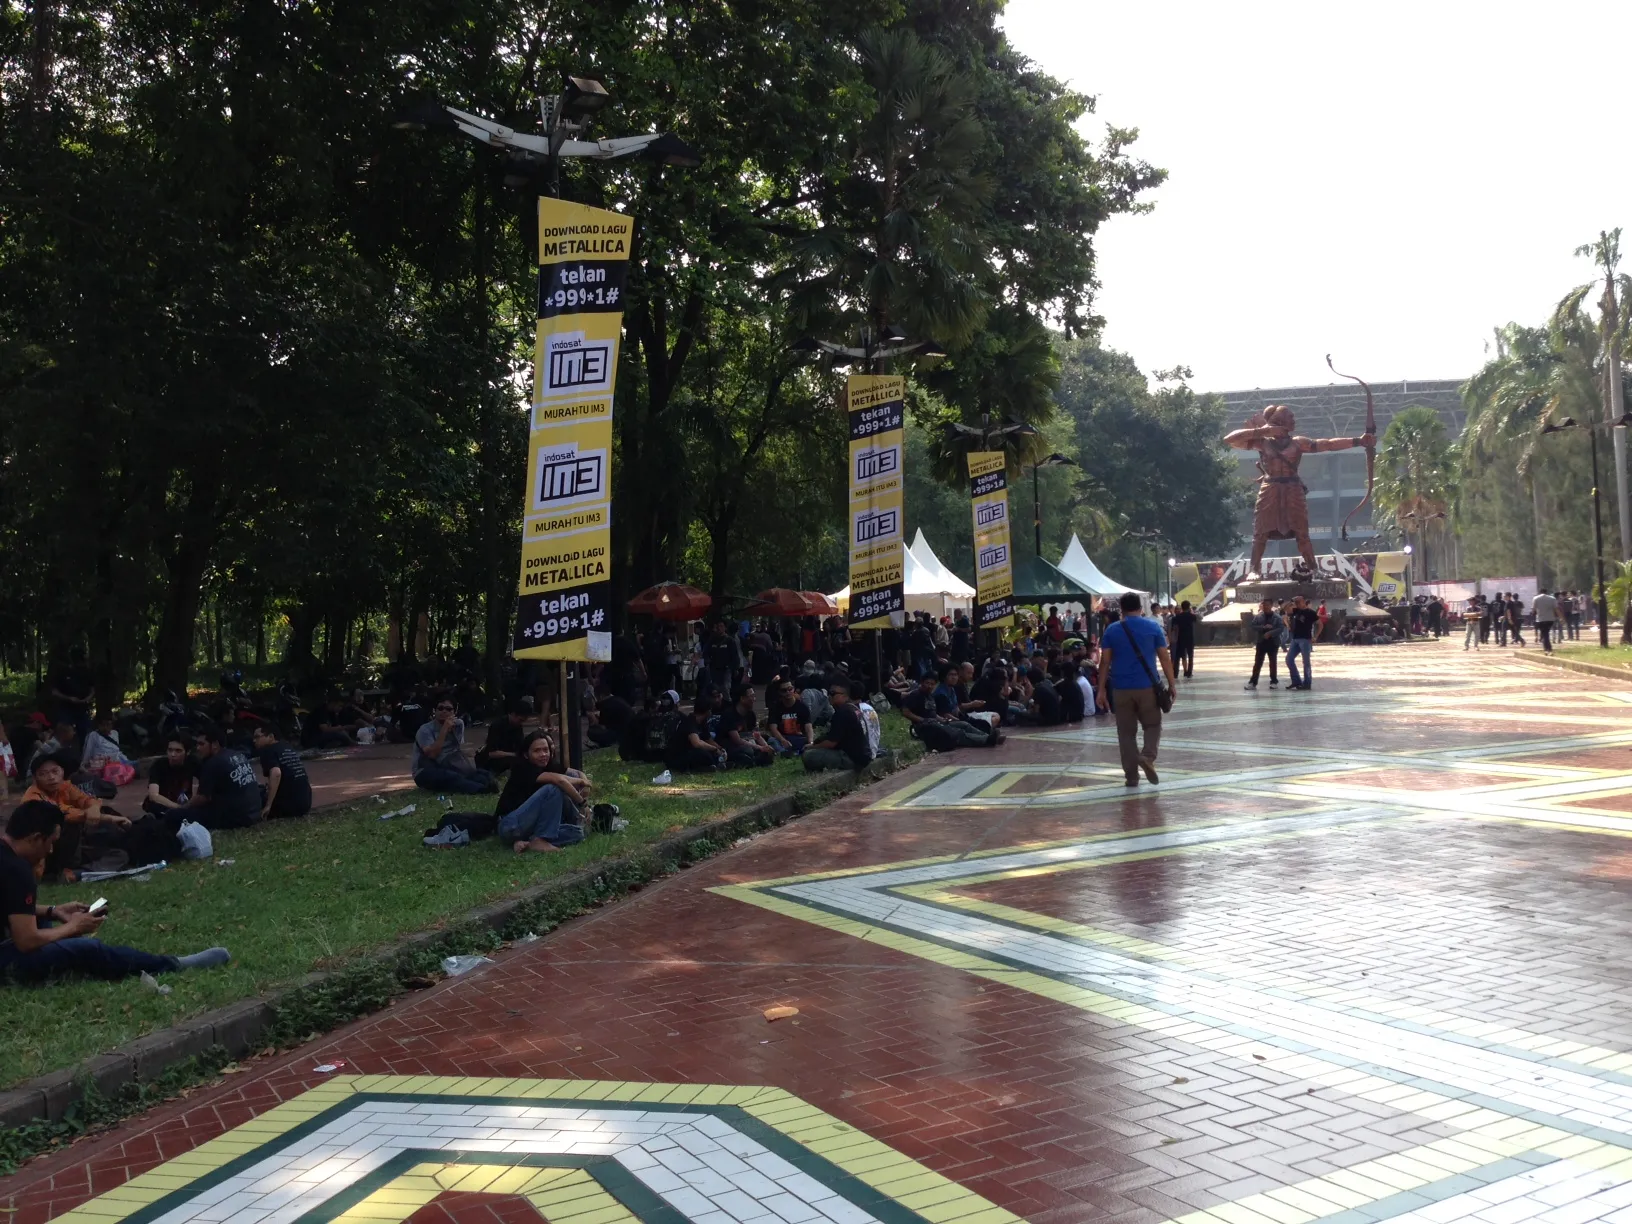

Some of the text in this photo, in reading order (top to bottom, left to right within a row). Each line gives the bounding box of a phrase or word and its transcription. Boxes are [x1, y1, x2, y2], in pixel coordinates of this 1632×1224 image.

[544, 225, 627, 238] DOWNLOAD LAGU
[544, 239, 625, 257] METALLICA
[559, 265, 606, 285] tekan
[551, 340, 582, 350] indosat
[549, 346, 608, 389] IM3
[885, 380, 901, 389] LAGU
[851, 389, 901, 407] METALLICA
[544, 407, 578, 420] MURAH
[591, 404, 605, 414] IM3
[860, 406, 891, 422] tekan
[544, 450, 576, 462] indosat
[857, 448, 897, 480] IM3
[970, 461, 1003, 474] METALLICA
[540, 456, 601, 501] IM3
[977, 473, 998, 485] tekan
[535, 518, 572, 533] MURAH
[586, 512, 601, 524] IM3
[856, 510, 896, 542] IM3
[582, 547, 605, 559] LAGU
[525, 561, 605, 587] METALLICA
[885, 562, 901, 572] LAGU
[851, 571, 901, 590] METALLICA
[861, 589, 891, 605] tekan
[980, 587, 1011, 602] METALLICA
[539, 592, 590, 616] tekan
[986, 599, 1006, 612] tekan
